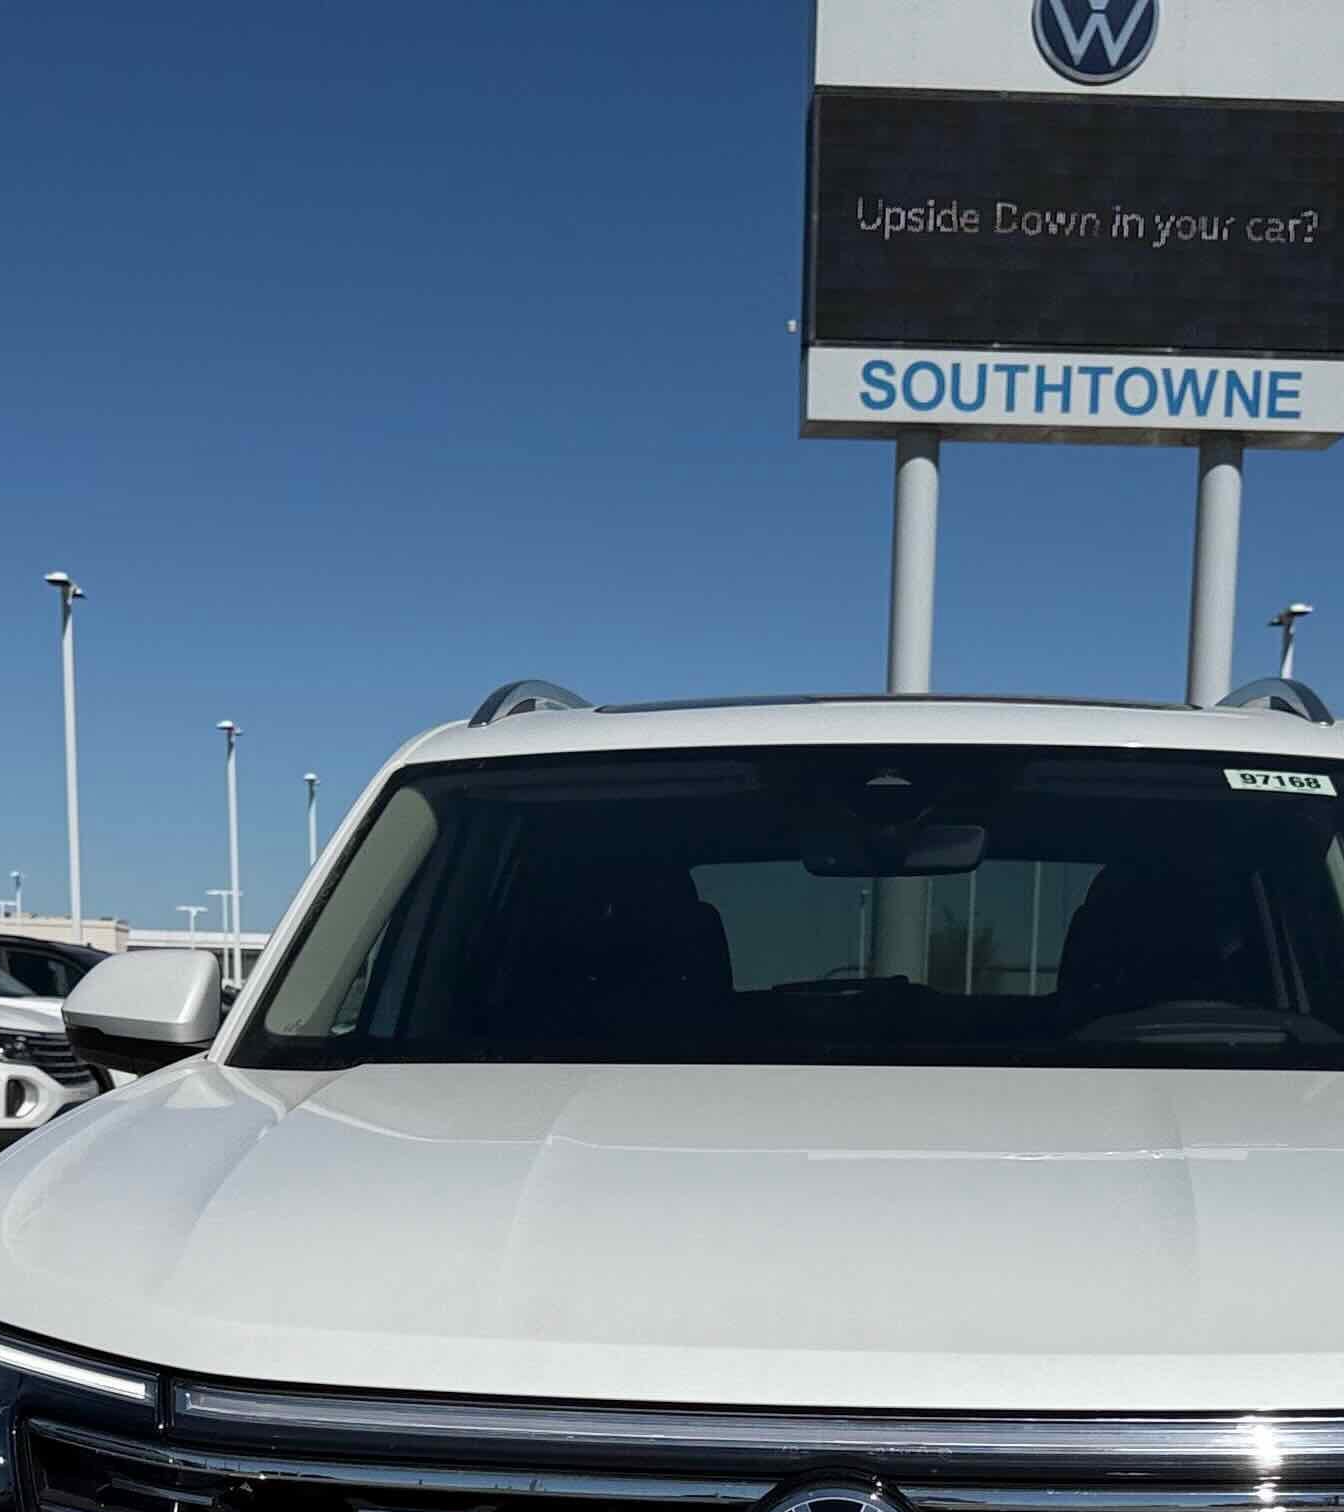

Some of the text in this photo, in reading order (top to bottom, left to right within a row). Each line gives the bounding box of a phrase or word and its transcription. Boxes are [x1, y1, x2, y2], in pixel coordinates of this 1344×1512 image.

[857, 197, 1318, 248] Upside Down in your car?
[859, 359, 1303, 419] SOUTHTOWNE
[1239, 773, 1321, 789] 97168
